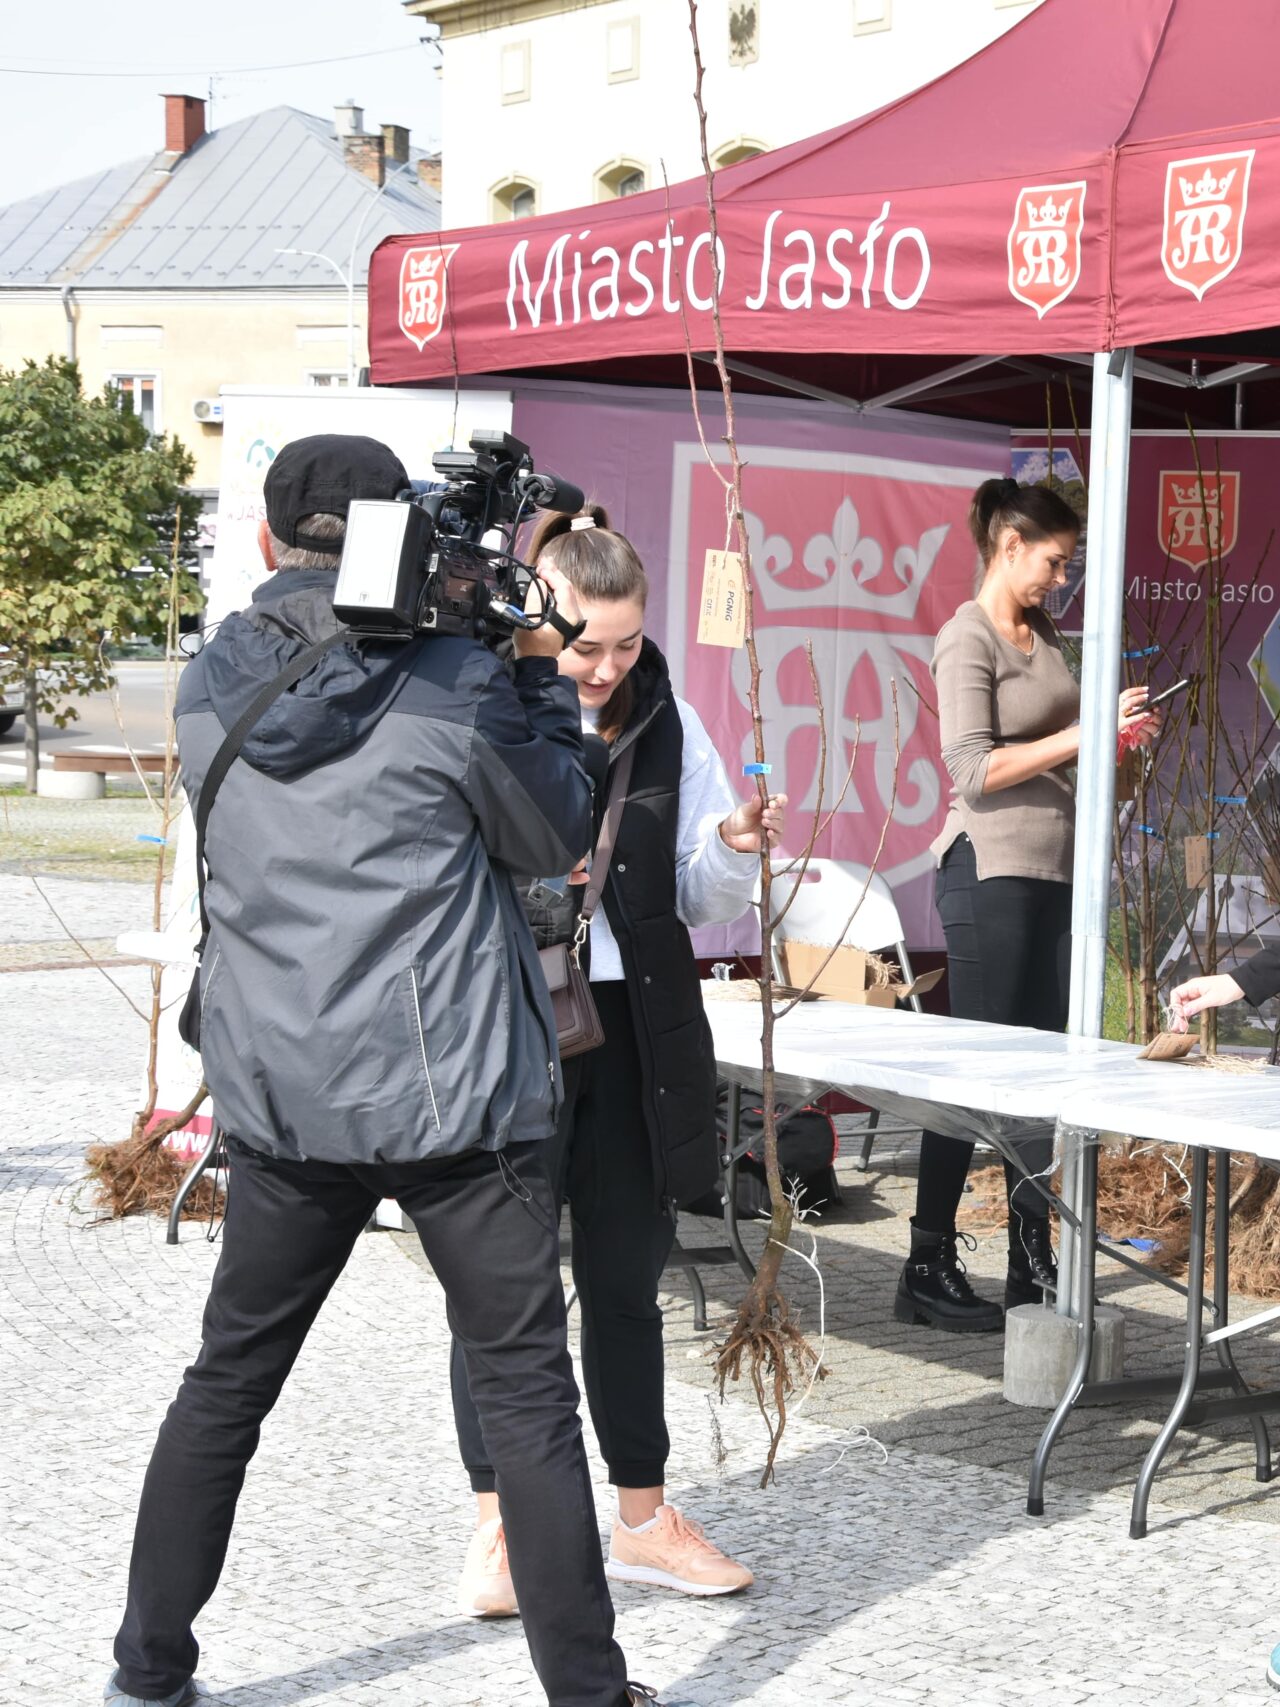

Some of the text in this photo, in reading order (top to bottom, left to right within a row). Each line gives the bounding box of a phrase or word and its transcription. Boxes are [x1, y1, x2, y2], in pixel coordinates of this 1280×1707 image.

[506, 219, 726, 330] Miasto
[746, 201, 931, 310] Jasło
[725, 590, 736, 623] PGNiG
